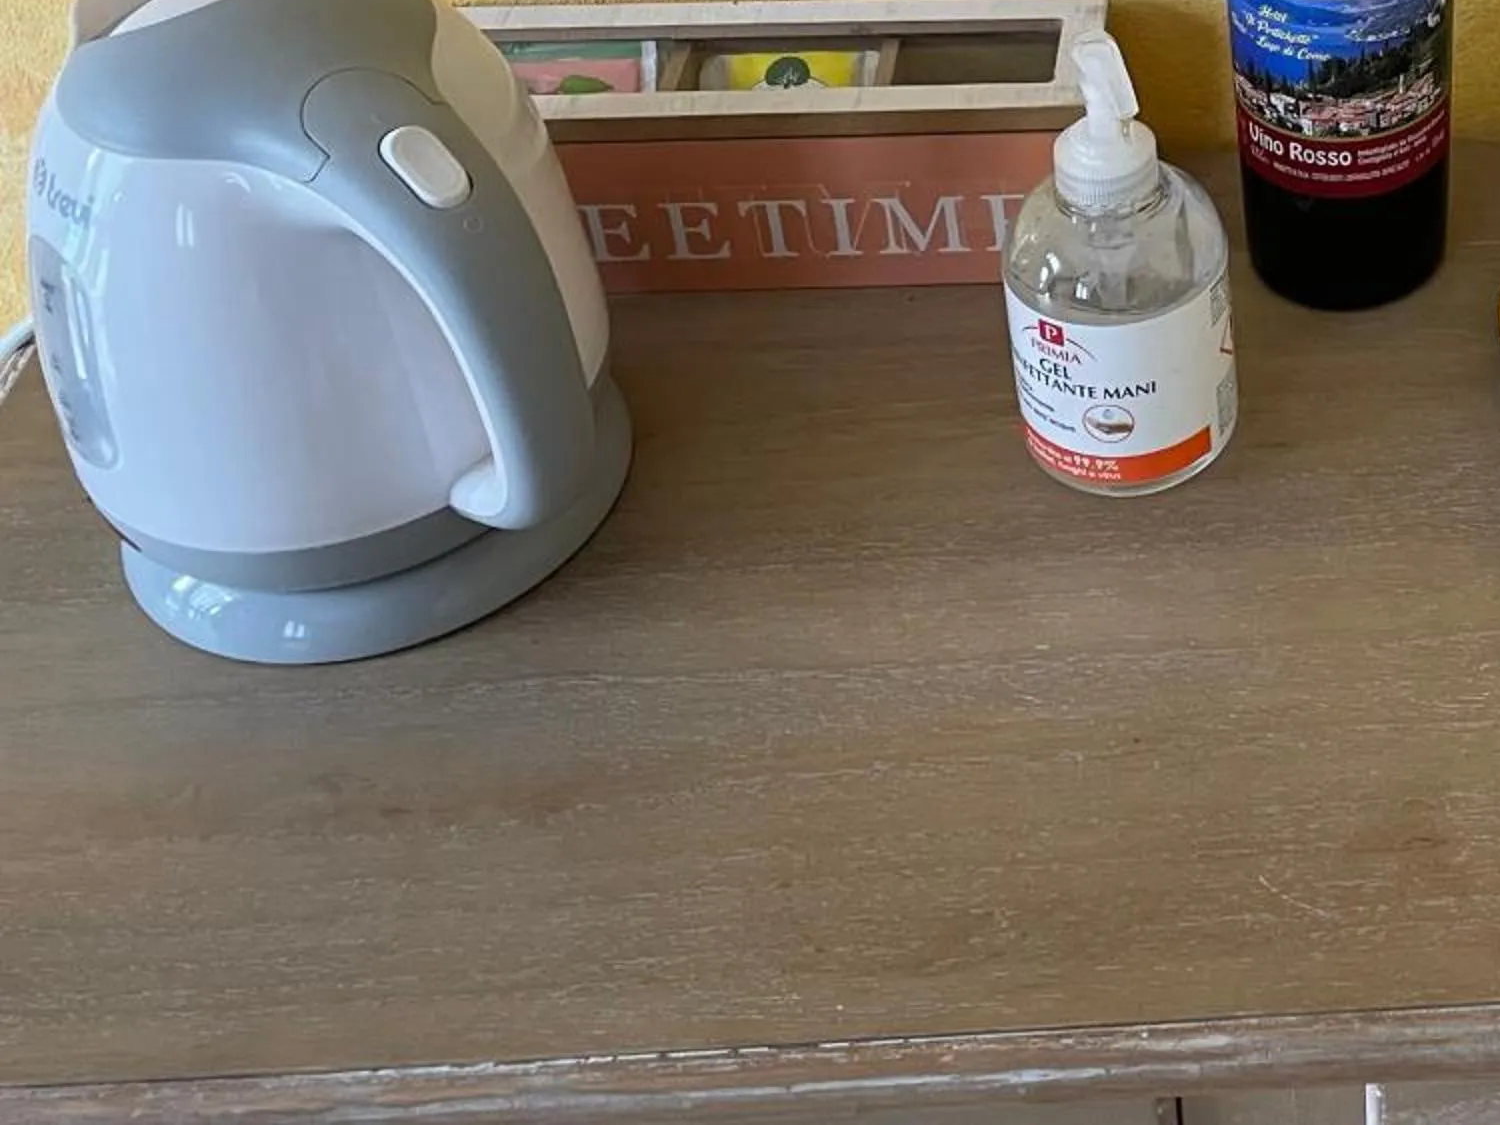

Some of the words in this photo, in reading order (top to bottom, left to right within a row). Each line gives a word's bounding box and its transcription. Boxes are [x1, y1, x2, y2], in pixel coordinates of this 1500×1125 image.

[1249, 121, 1284, 156] Vino
[1289, 142, 1352, 167] Rosso
[1040, 357, 1072, 380] GEL
[1103, 380, 1157, 400] MANI
